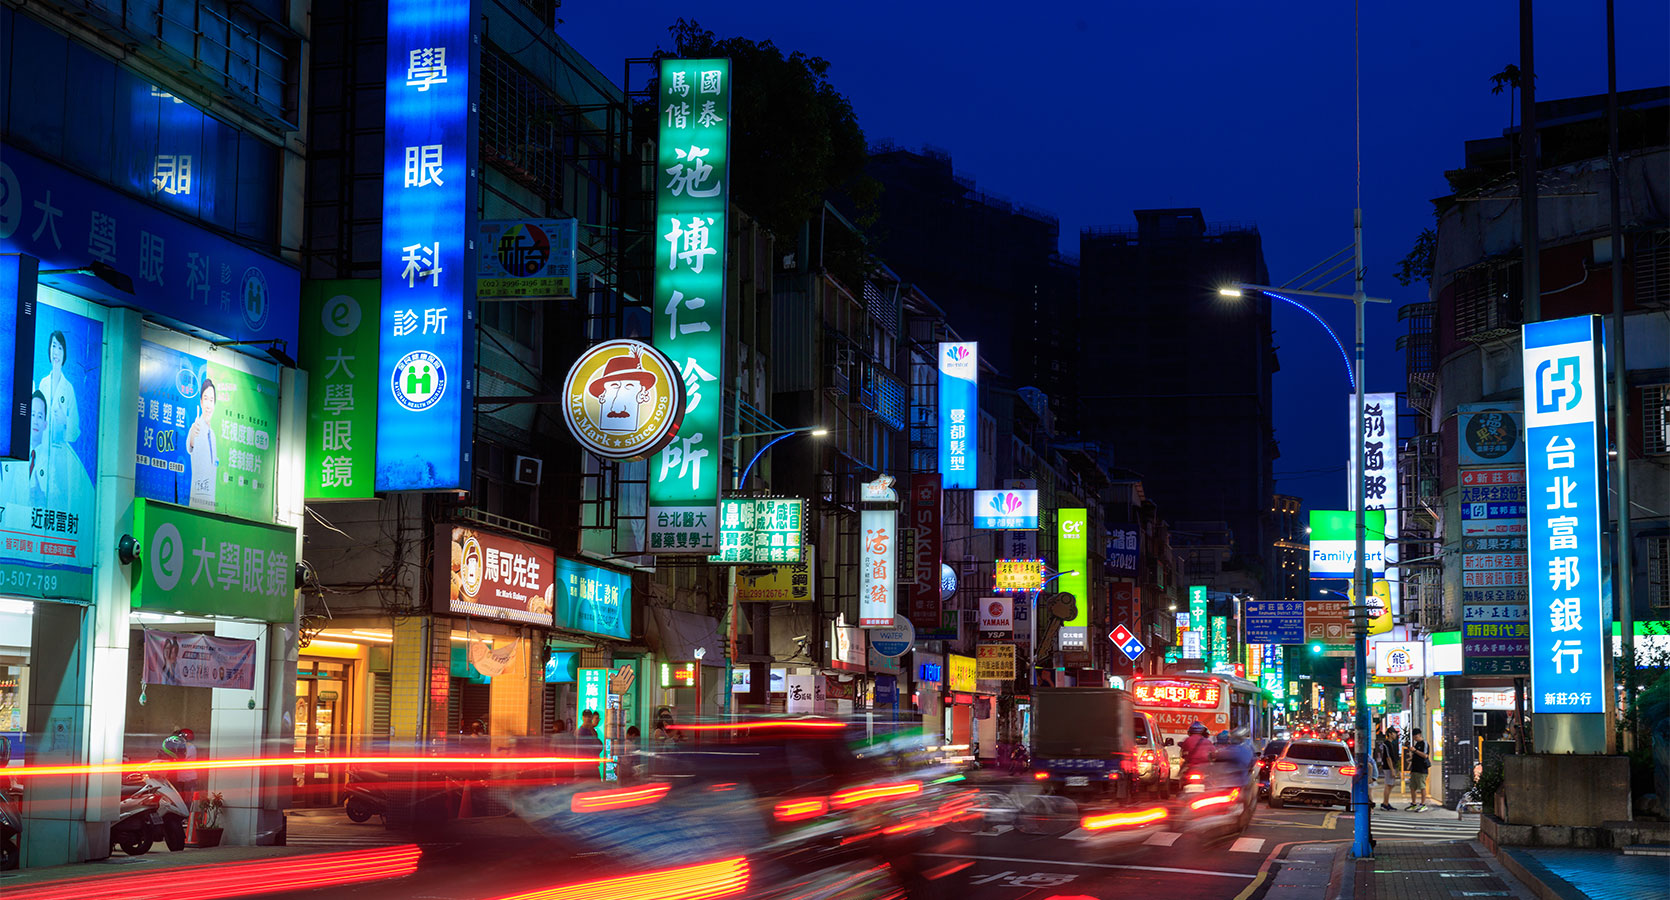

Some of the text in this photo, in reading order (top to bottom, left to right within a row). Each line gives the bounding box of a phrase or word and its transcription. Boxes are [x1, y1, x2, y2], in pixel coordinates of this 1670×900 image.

[666, 72, 692, 129] 馬偕
[698, 71, 723, 129] 國泰
[31, 191, 210, 306] 大學眼科
[393, 307, 448, 336] 診所
[658, 145, 721, 491] 施博仁診所
[321, 347, 355, 488] 大學眼鏡
[624, 423, 656, 447] since
[653, 396, 668, 422] 1998
[950, 409, 965, 471] 曼都髮型
[31, 507, 79, 534] 近視雷射
[657, 511, 707, 528] 台北醫大
[756, 501, 776, 515] 小兒
[775, 503, 801, 530] 感冒
[756, 517, 775, 530] 成人
[651, 532, 713, 549] 醫藥雙學士
[720, 532, 754, 547] 胃炎
[755, 532, 800, 547] 高血壓
[917, 509, 932, 596] SAKURA
[191, 537, 289, 598] 大學眼鏡
[755, 548, 800, 562] 慢性病
[1312, 550, 1382, 563] Familyart
[1545, 435, 1583, 674] 台北富邦銀行
[485, 548, 540, 590] 馬可先生
[1466, 624, 1528, 637] 新時代美
[1136, 687, 1165, 698] 板橋
[1189, 689, 1219, 701] 新莊
[1545, 692, 1592, 705] 新莊分行
